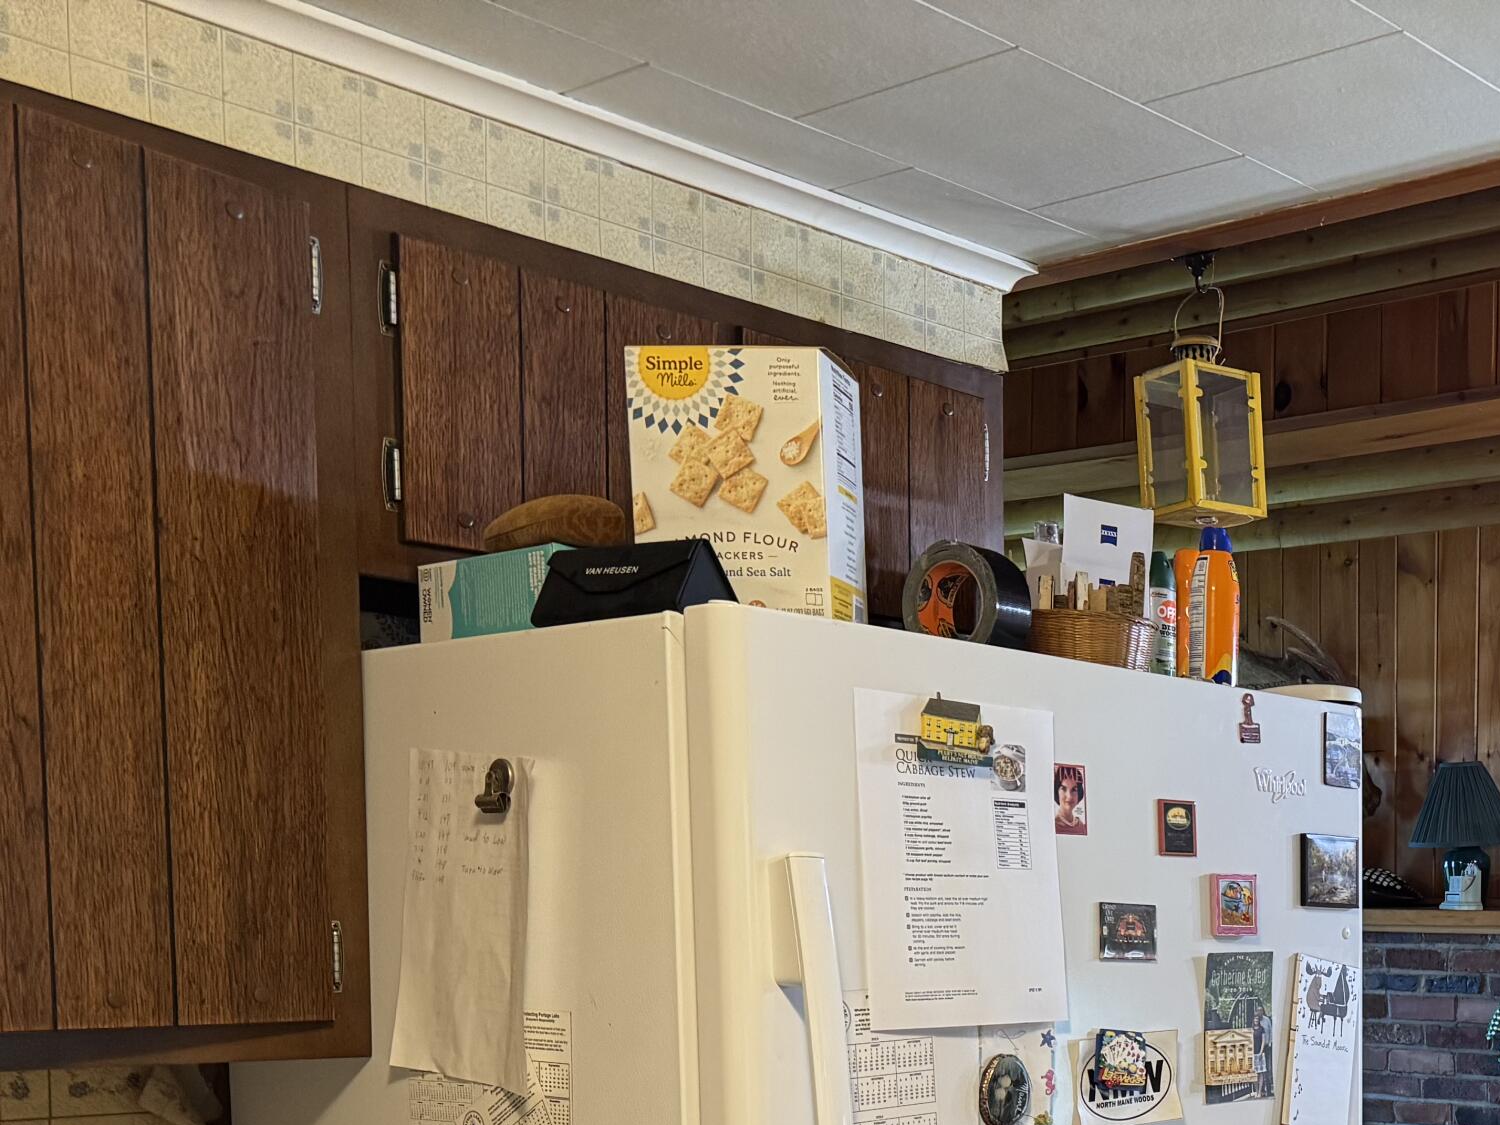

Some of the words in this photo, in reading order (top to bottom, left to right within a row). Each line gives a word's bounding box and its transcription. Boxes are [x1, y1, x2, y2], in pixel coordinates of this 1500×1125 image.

[646, 356, 703, 373] Simple
[657, 372, 697, 387] Mills
[743, 532, 800, 552] FLOUR
[716, 552, 764, 560] ACKERS
[602, 566, 638, 575] HEUSEN
[746, 567, 766, 577] Sea
[770, 566, 791, 577] Salt
[896, 763, 944, 776] CABBAGE
[1055, 767, 1084, 783] IME
[1254, 767, 1307, 803] Whirlpool
[1212, 969, 1246, 986] Catherine
[1087, 1060, 1164, 1102] NW
[1096, 1100, 1116, 1109] NORTH
[1117, 1098, 1133, 1106] MAINE
[1133, 1095, 1155, 1104] WOODS
